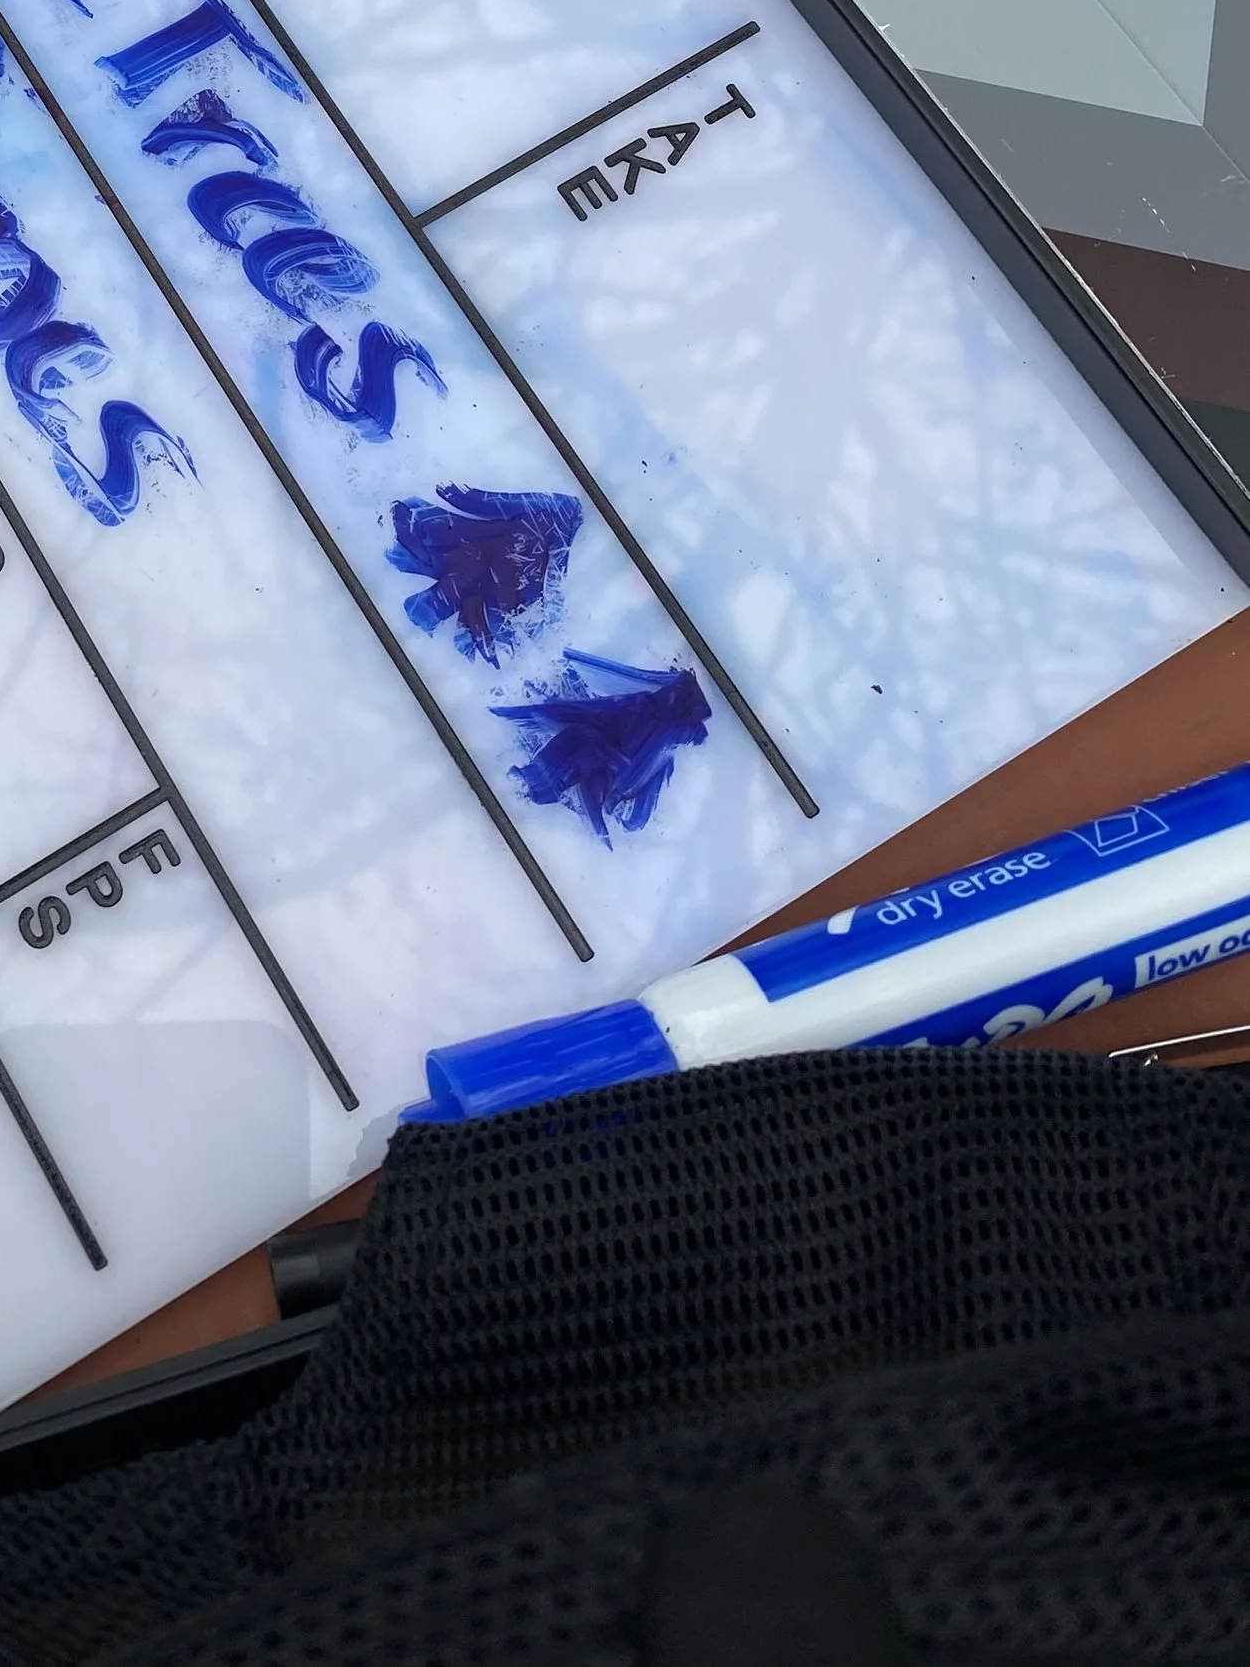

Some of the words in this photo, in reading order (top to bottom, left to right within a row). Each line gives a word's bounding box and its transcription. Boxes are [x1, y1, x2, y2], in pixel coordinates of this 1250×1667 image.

[557, 83, 756, 222] TAKE
[18, 829, 181, 949] FPS
[876, 889, 943, 925] dry
[948, 851, 1051, 898] erase
[1148, 945, 1210, 982] low
